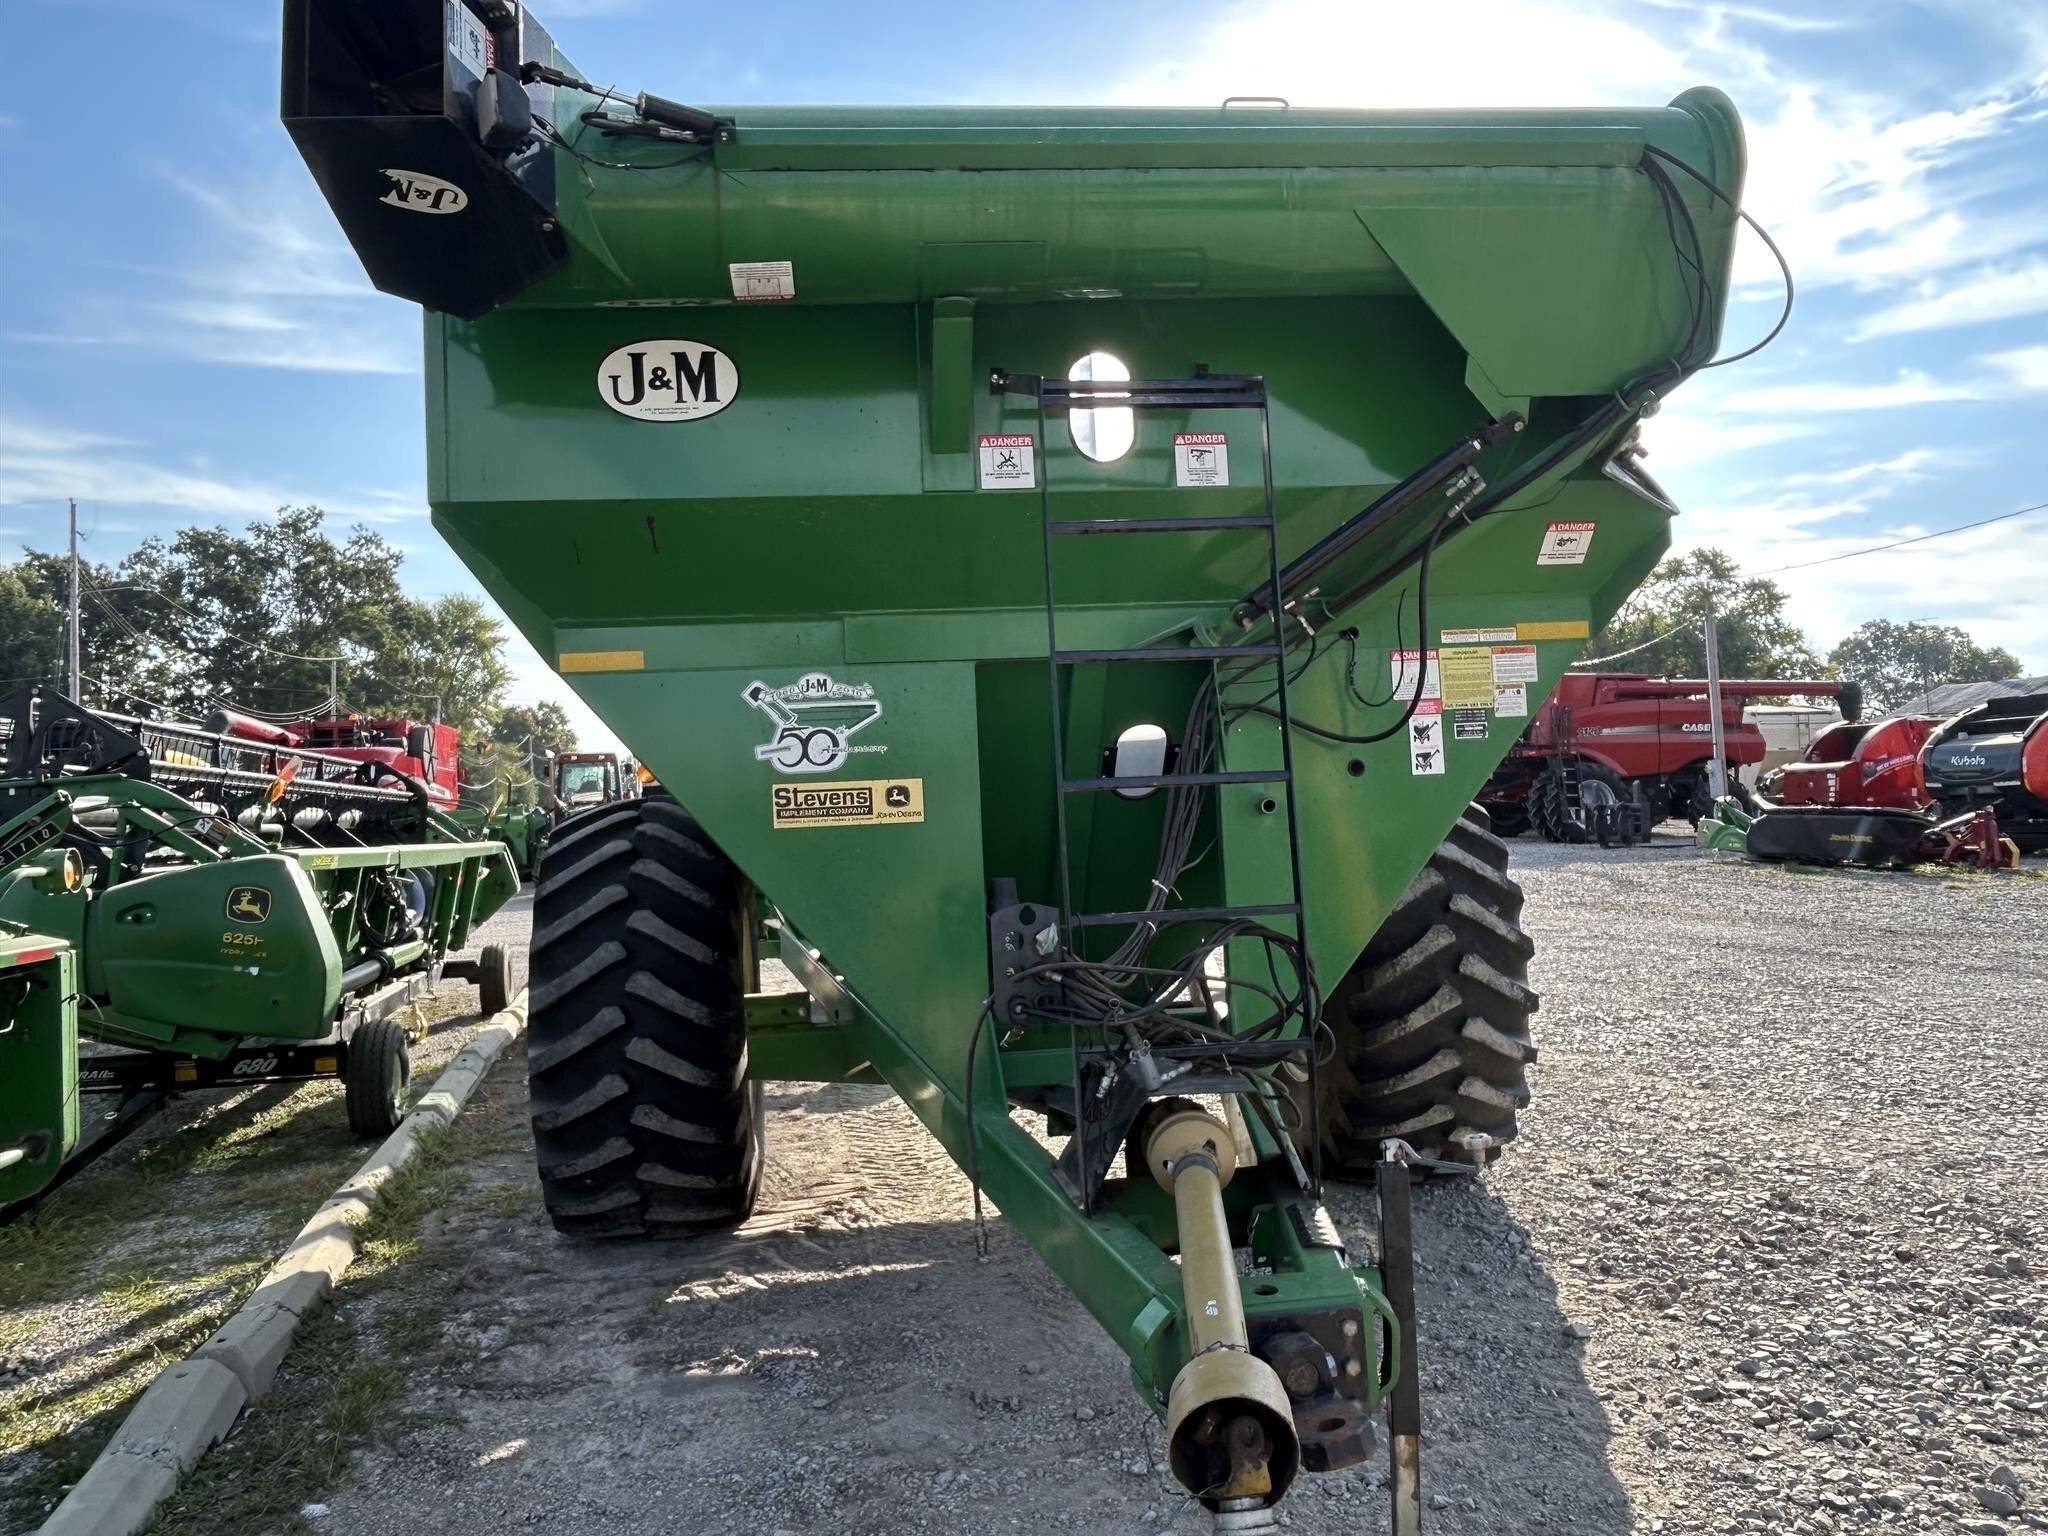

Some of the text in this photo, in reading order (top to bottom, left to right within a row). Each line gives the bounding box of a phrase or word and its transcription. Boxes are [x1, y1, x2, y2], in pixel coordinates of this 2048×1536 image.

[608, 351, 721, 406] J&M
[989, 437, 1033, 447] DANGER
[1184, 434, 1226, 444] DANGER
[1557, 523, 1596, 531] DANGER
[1402, 651, 1438, 660] DANER
[801, 678, 829, 693] J&M
[1681, 723, 1712, 732] CASE
[777, 726, 840, 768] 50
[1951, 755, 1986, 766] Kubota
[774, 787, 869, 808] Stevens
[780, 807, 869, 817] IMPLEMENT COMPANY
[232, 1058, 278, 1075] 680
